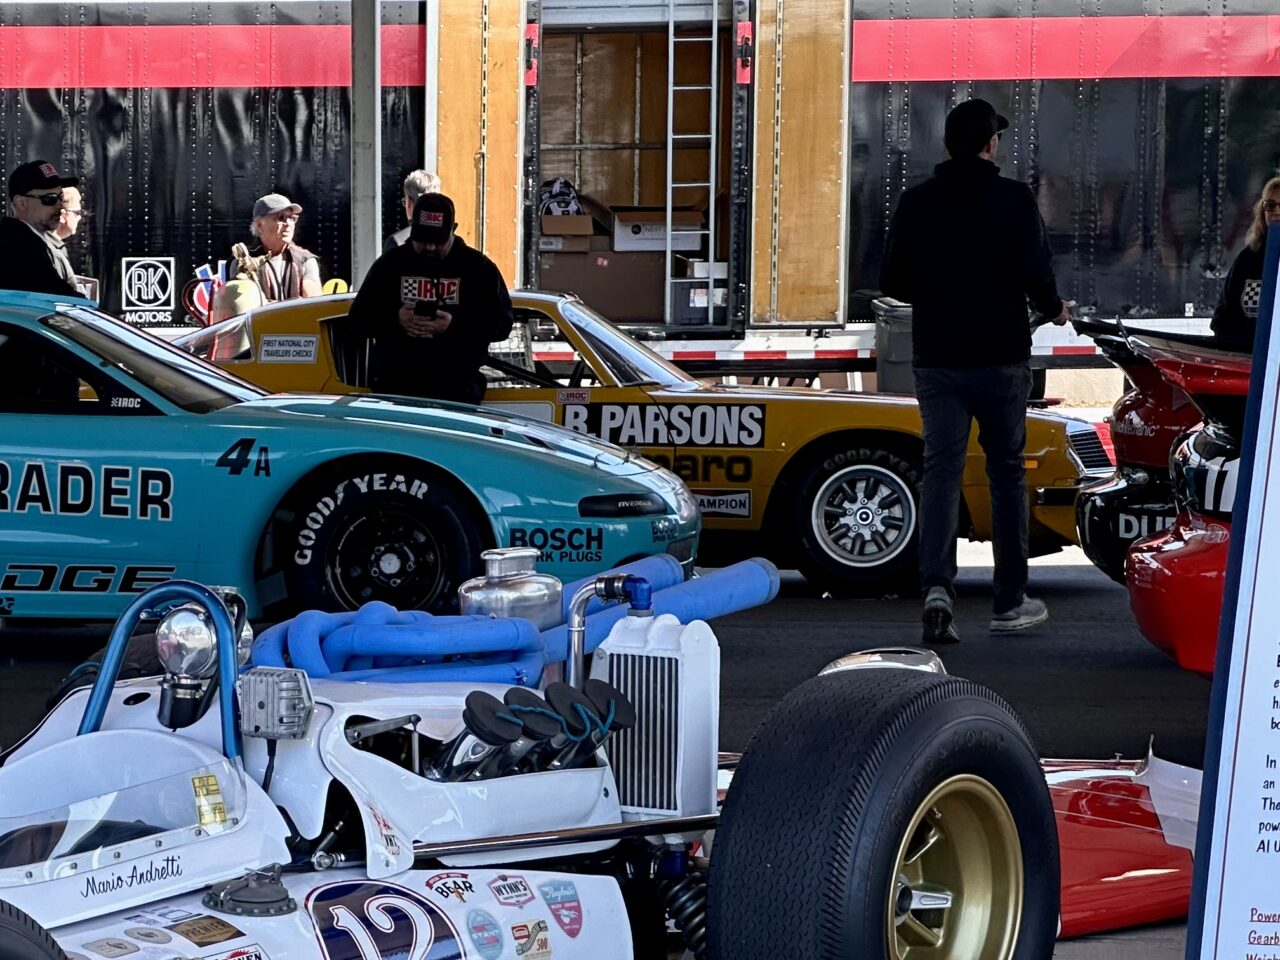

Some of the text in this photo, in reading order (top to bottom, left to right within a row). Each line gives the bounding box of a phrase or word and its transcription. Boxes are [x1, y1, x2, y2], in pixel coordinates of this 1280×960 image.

[131, 268, 164, 300] RK
[124, 311, 172, 323] MOTORS
[263, 339, 315, 348] FIRST NATIONAL CITY
[263, 349, 312, 358] TRAVELERS CHECKS
[118, 398, 142, 408] IROC
[601, 404, 764, 445] PARSONS
[699, 498, 747, 510] AMPION
[509, 527, 603, 551] BOSCH
[560, 551, 603, 563] PLUGS
[1266, 754, 1277, 769] In
[1263, 780, 1275, 790] an
[1258, 822, 1280, 835] pow
[80, 855, 183, 898] Mario Andretti
[434, 880, 475, 899] BEAR
[492, 880, 528, 897] WYNN'S
